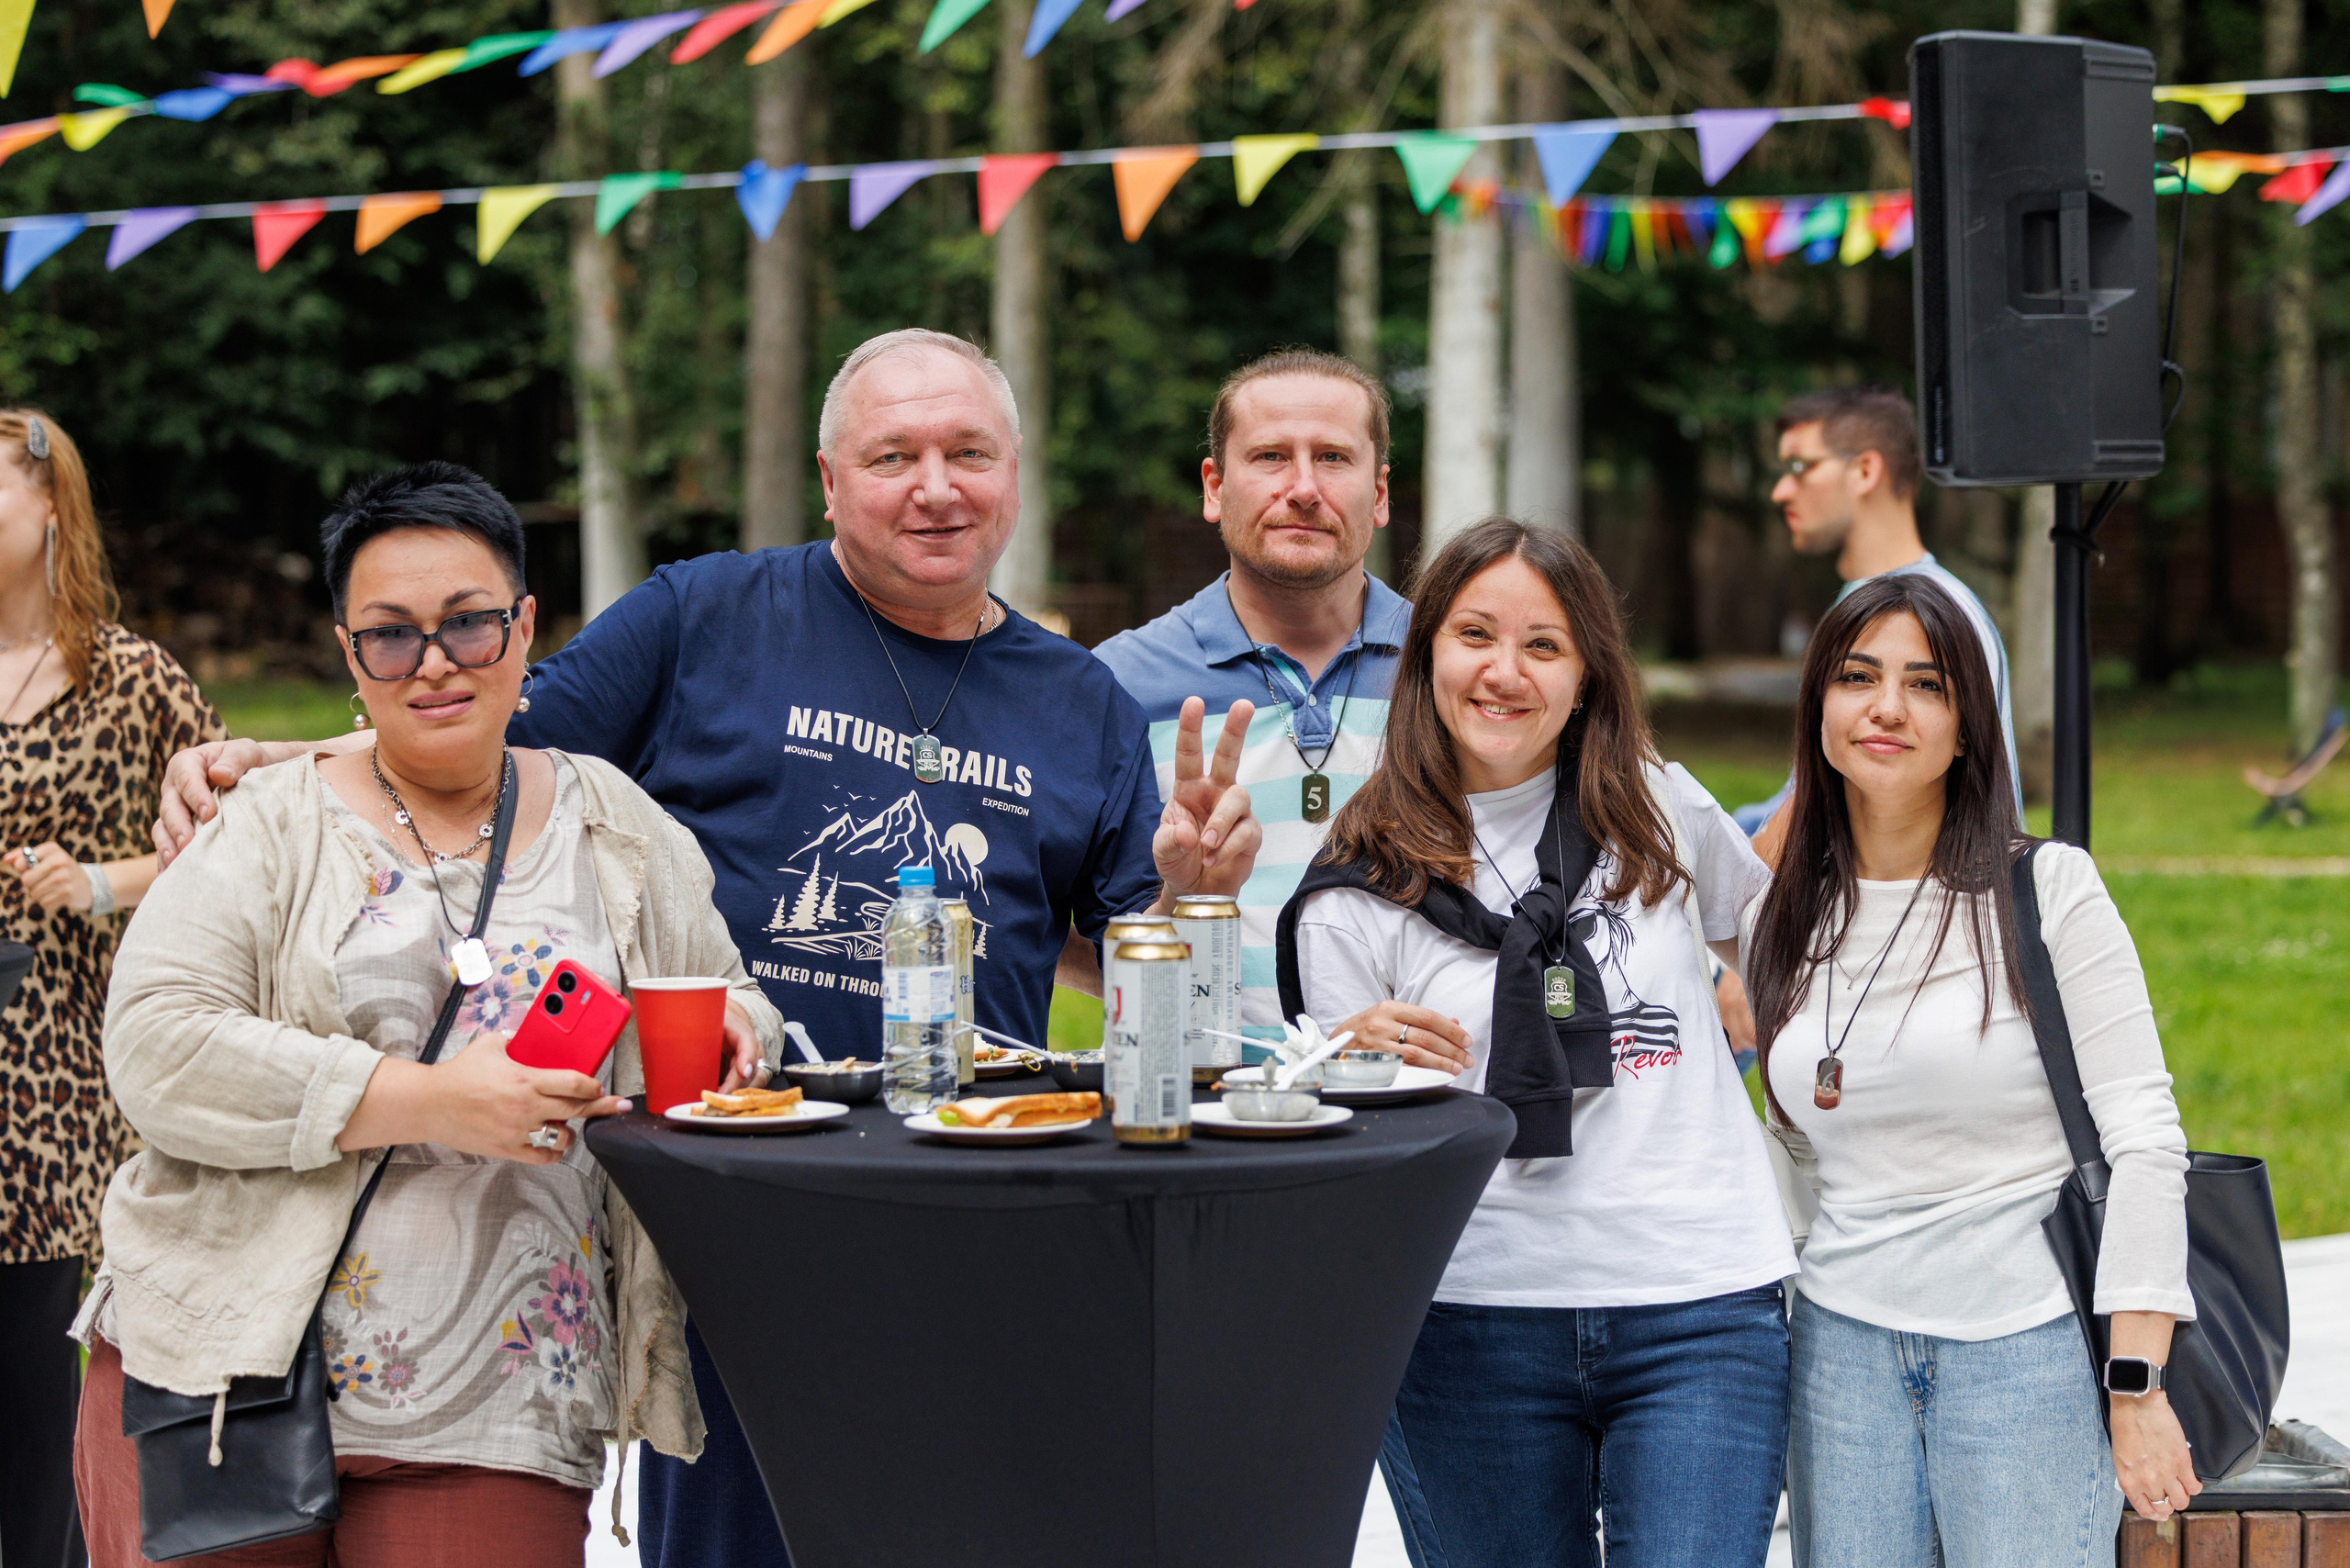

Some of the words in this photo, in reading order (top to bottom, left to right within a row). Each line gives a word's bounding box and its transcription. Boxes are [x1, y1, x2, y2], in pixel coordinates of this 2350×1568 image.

[784, 745, 834, 762] MOUNTAINS
[786, 705, 914, 770] NATURE
[941, 745, 1032, 798] RAILS
[923, 751, 933, 759] CS
[981, 797, 1030, 817] EXPEDITION
[1307, 786, 1322, 810] 5
[752, 960, 811, 984] WALKED
[813, 970, 836, 989] ON
[1822, 1071, 1836, 1098] 6
